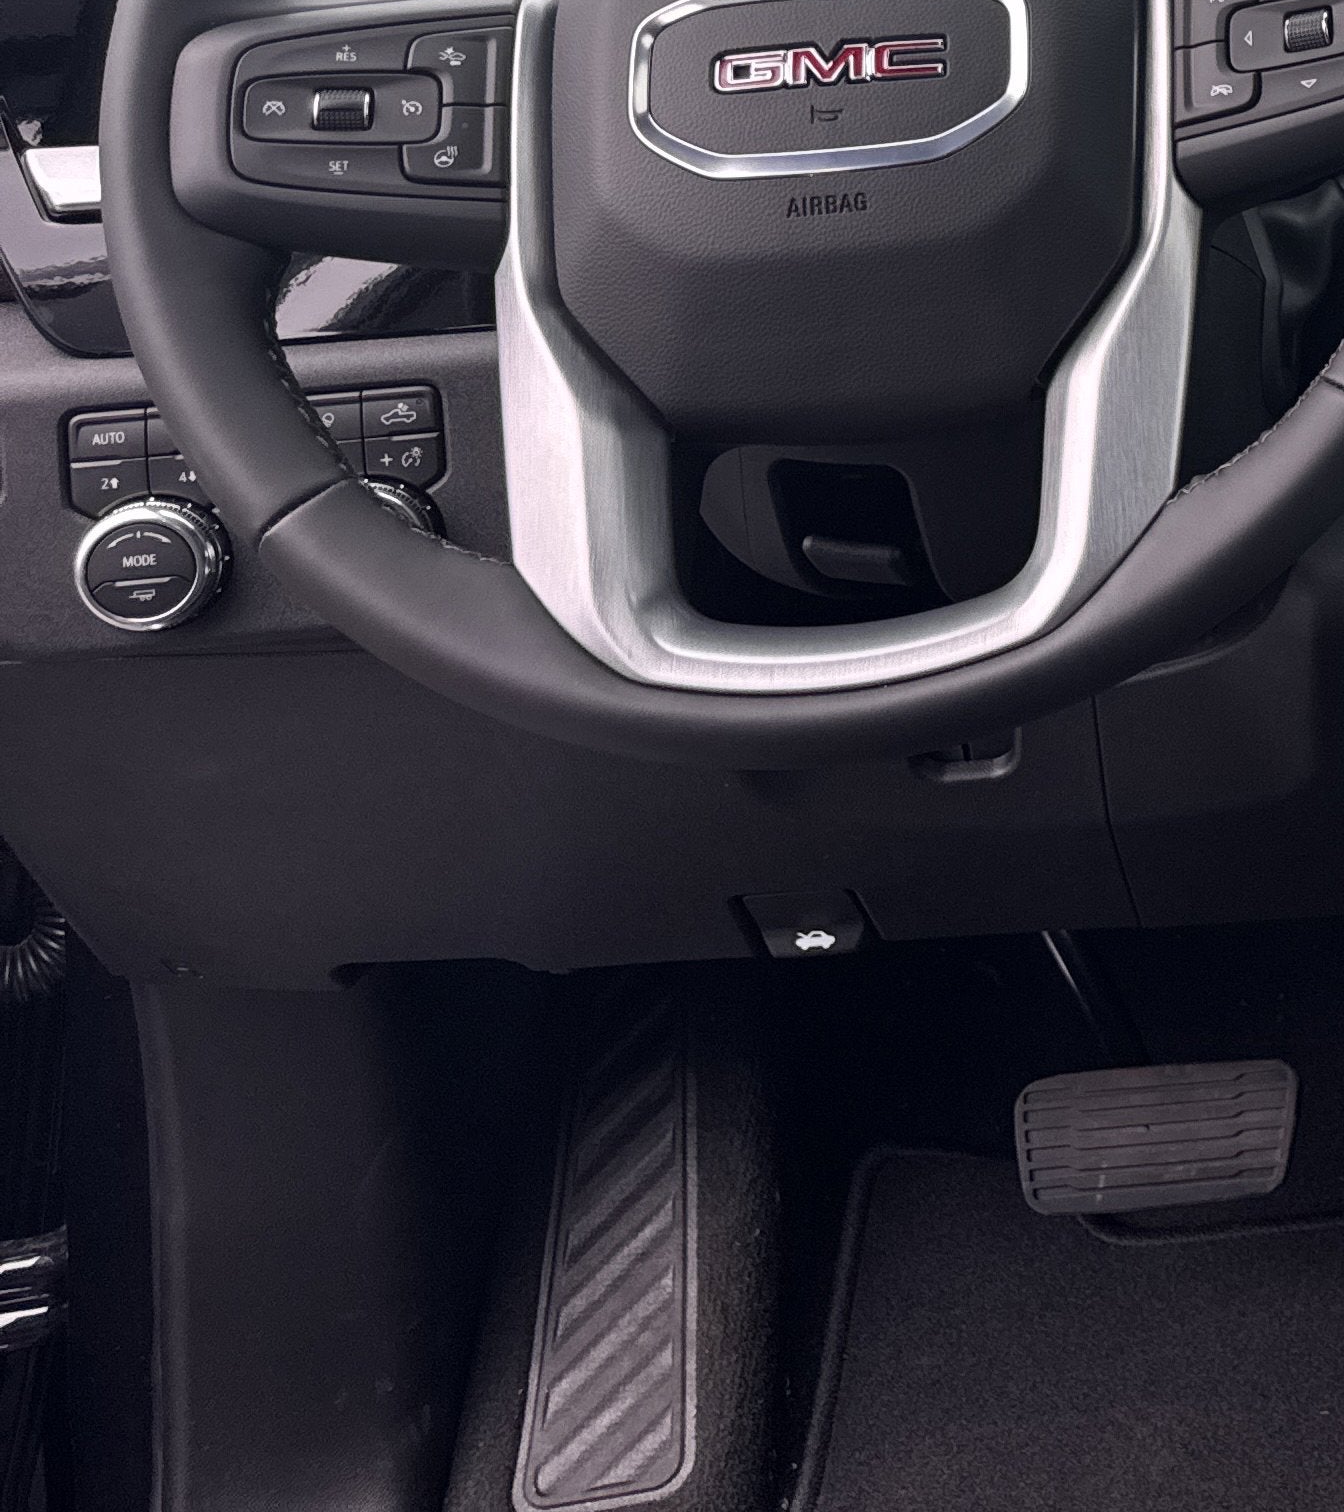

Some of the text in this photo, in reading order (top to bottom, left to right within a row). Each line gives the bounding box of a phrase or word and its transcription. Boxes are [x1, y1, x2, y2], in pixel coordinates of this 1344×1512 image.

[335, 52, 357, 62] RES
[714, 38, 945, 92] GMC
[328, 160, 349, 172] SET
[786, 192, 868, 218] AIRBAG
[92, 431, 125, 445] AUTO
[122, 554, 157, 568] MODE
